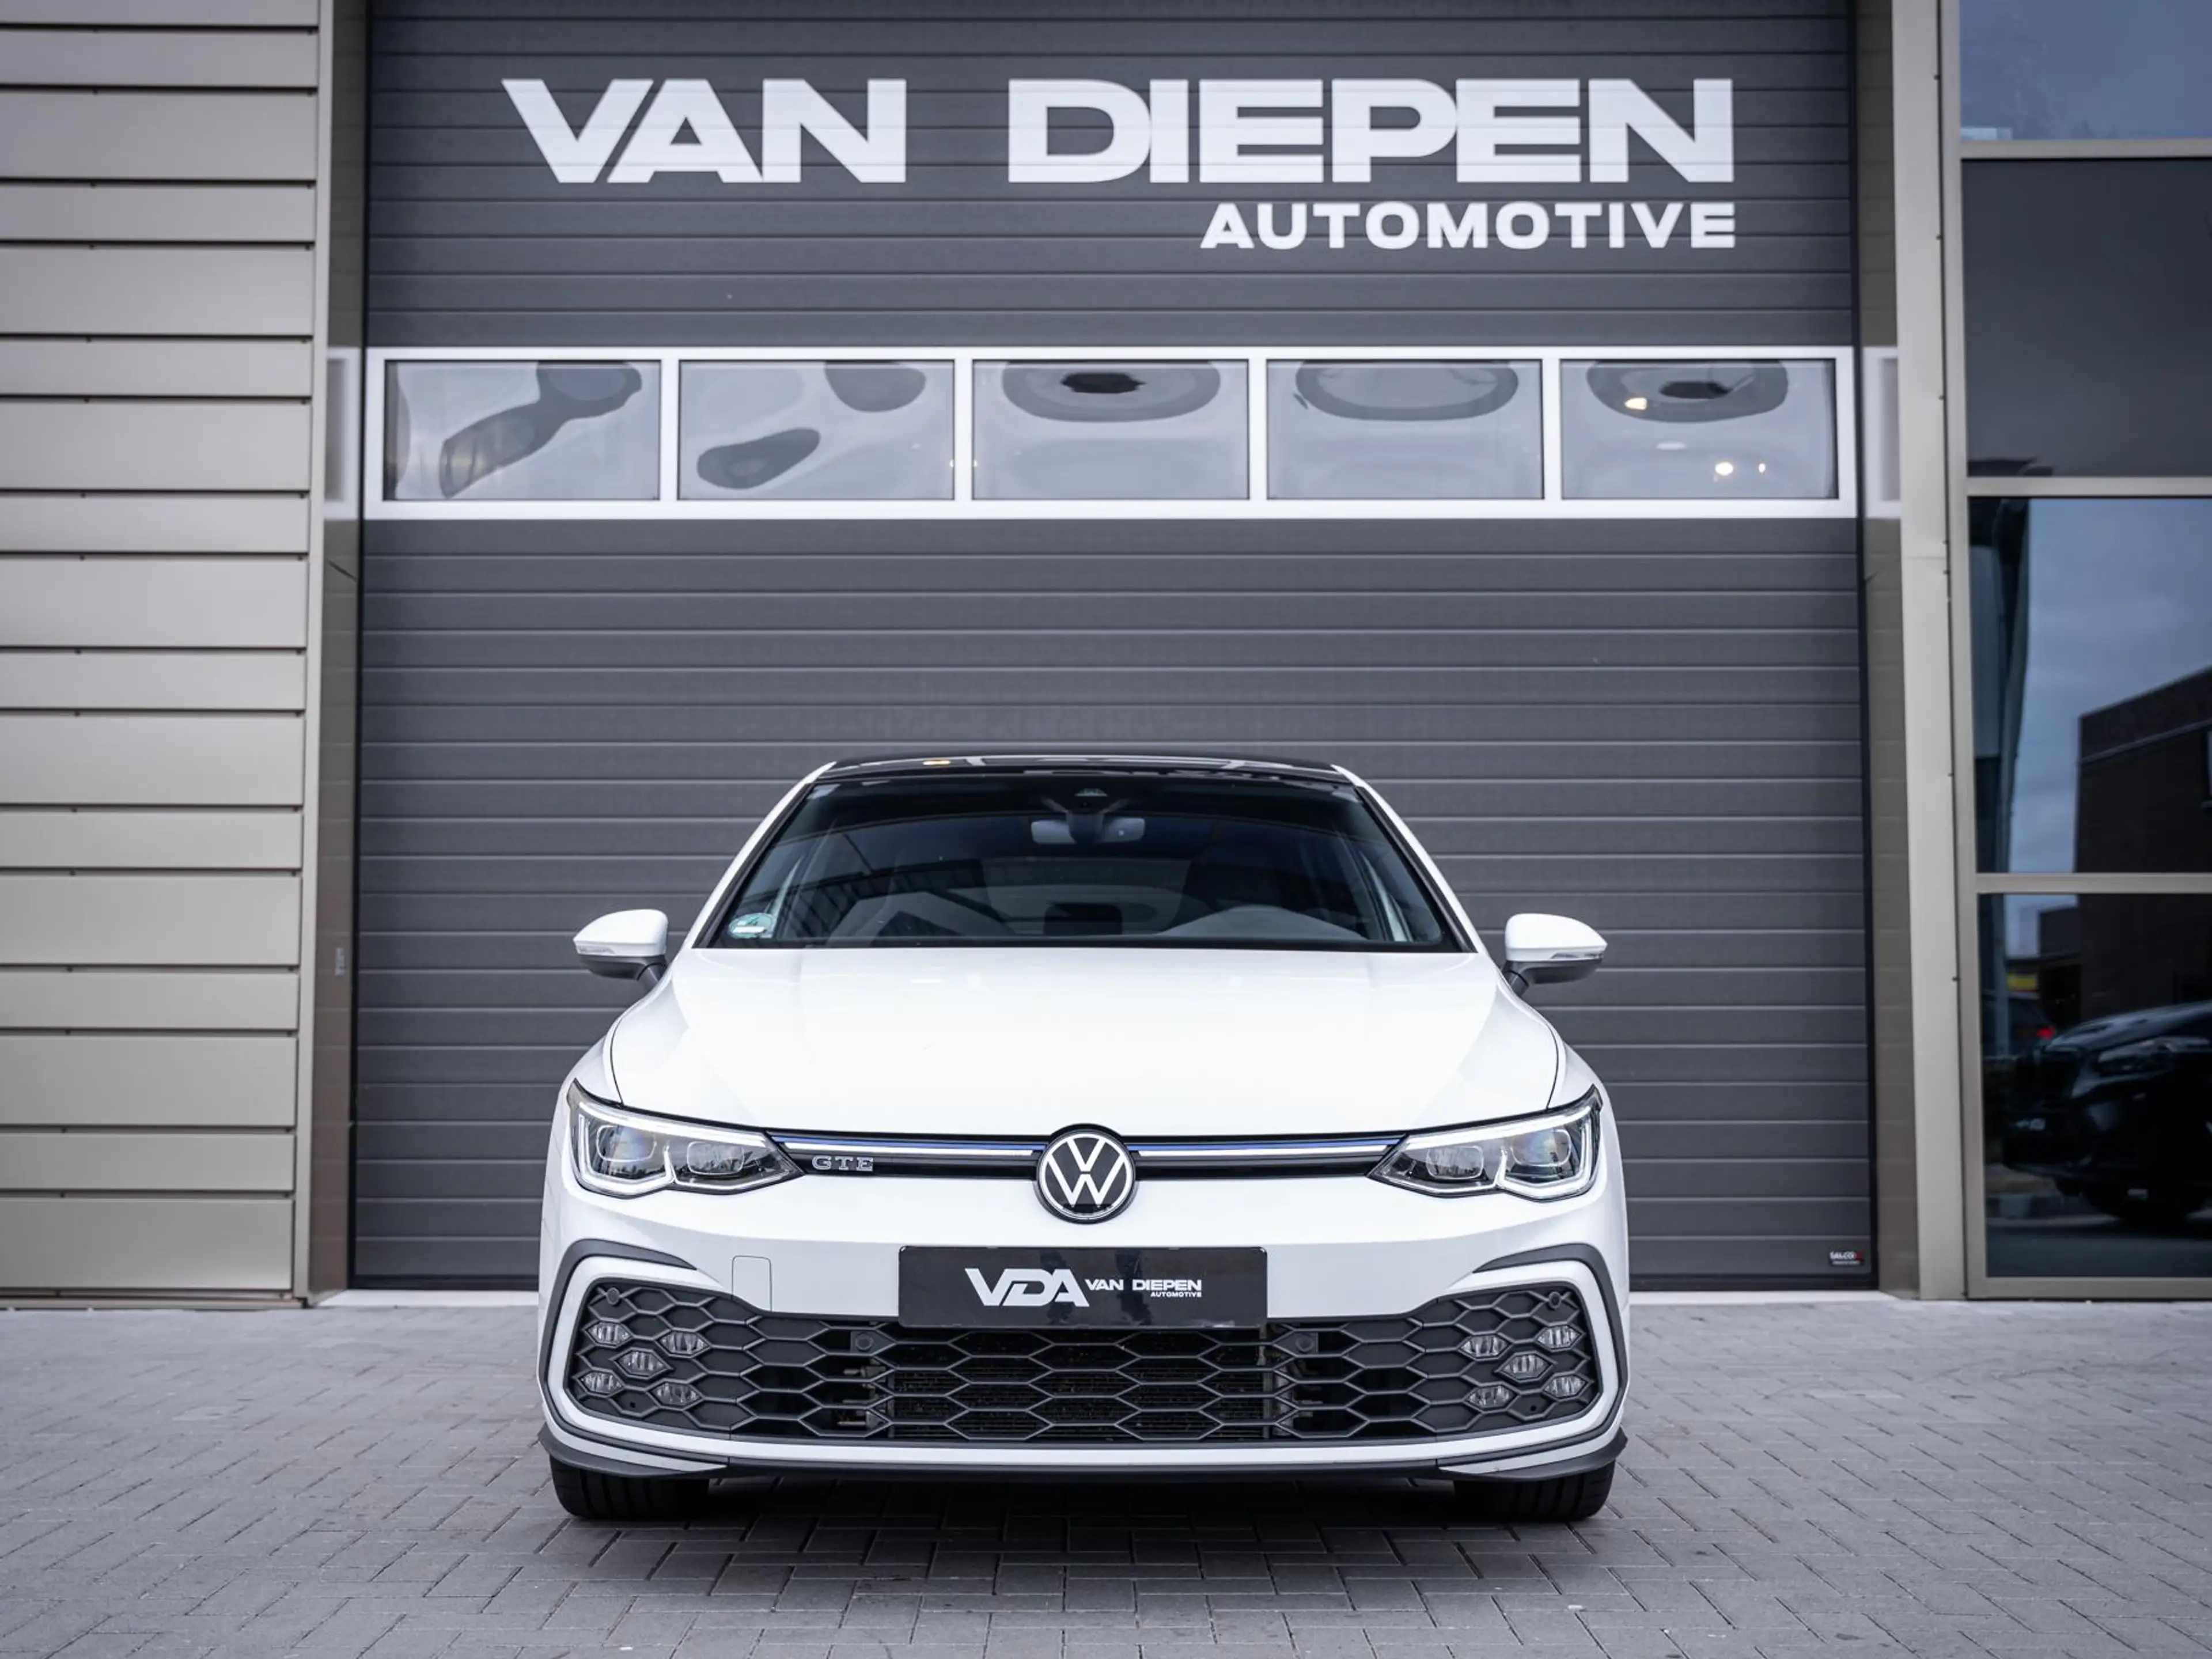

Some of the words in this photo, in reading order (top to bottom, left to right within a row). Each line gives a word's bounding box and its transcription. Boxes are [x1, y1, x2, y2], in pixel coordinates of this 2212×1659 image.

[502, 79, 907, 183] VAN
[1008, 79, 1734, 183] DIEPEN
[1200, 202, 1735, 250] AUTOMOTIVE
[812, 1154, 874, 1172] GTE
[964, 1267, 1090, 1308] VDA
[1085, 1278, 1124, 1291] VAN
[1132, 1279, 1202, 1291] DIEPEN
